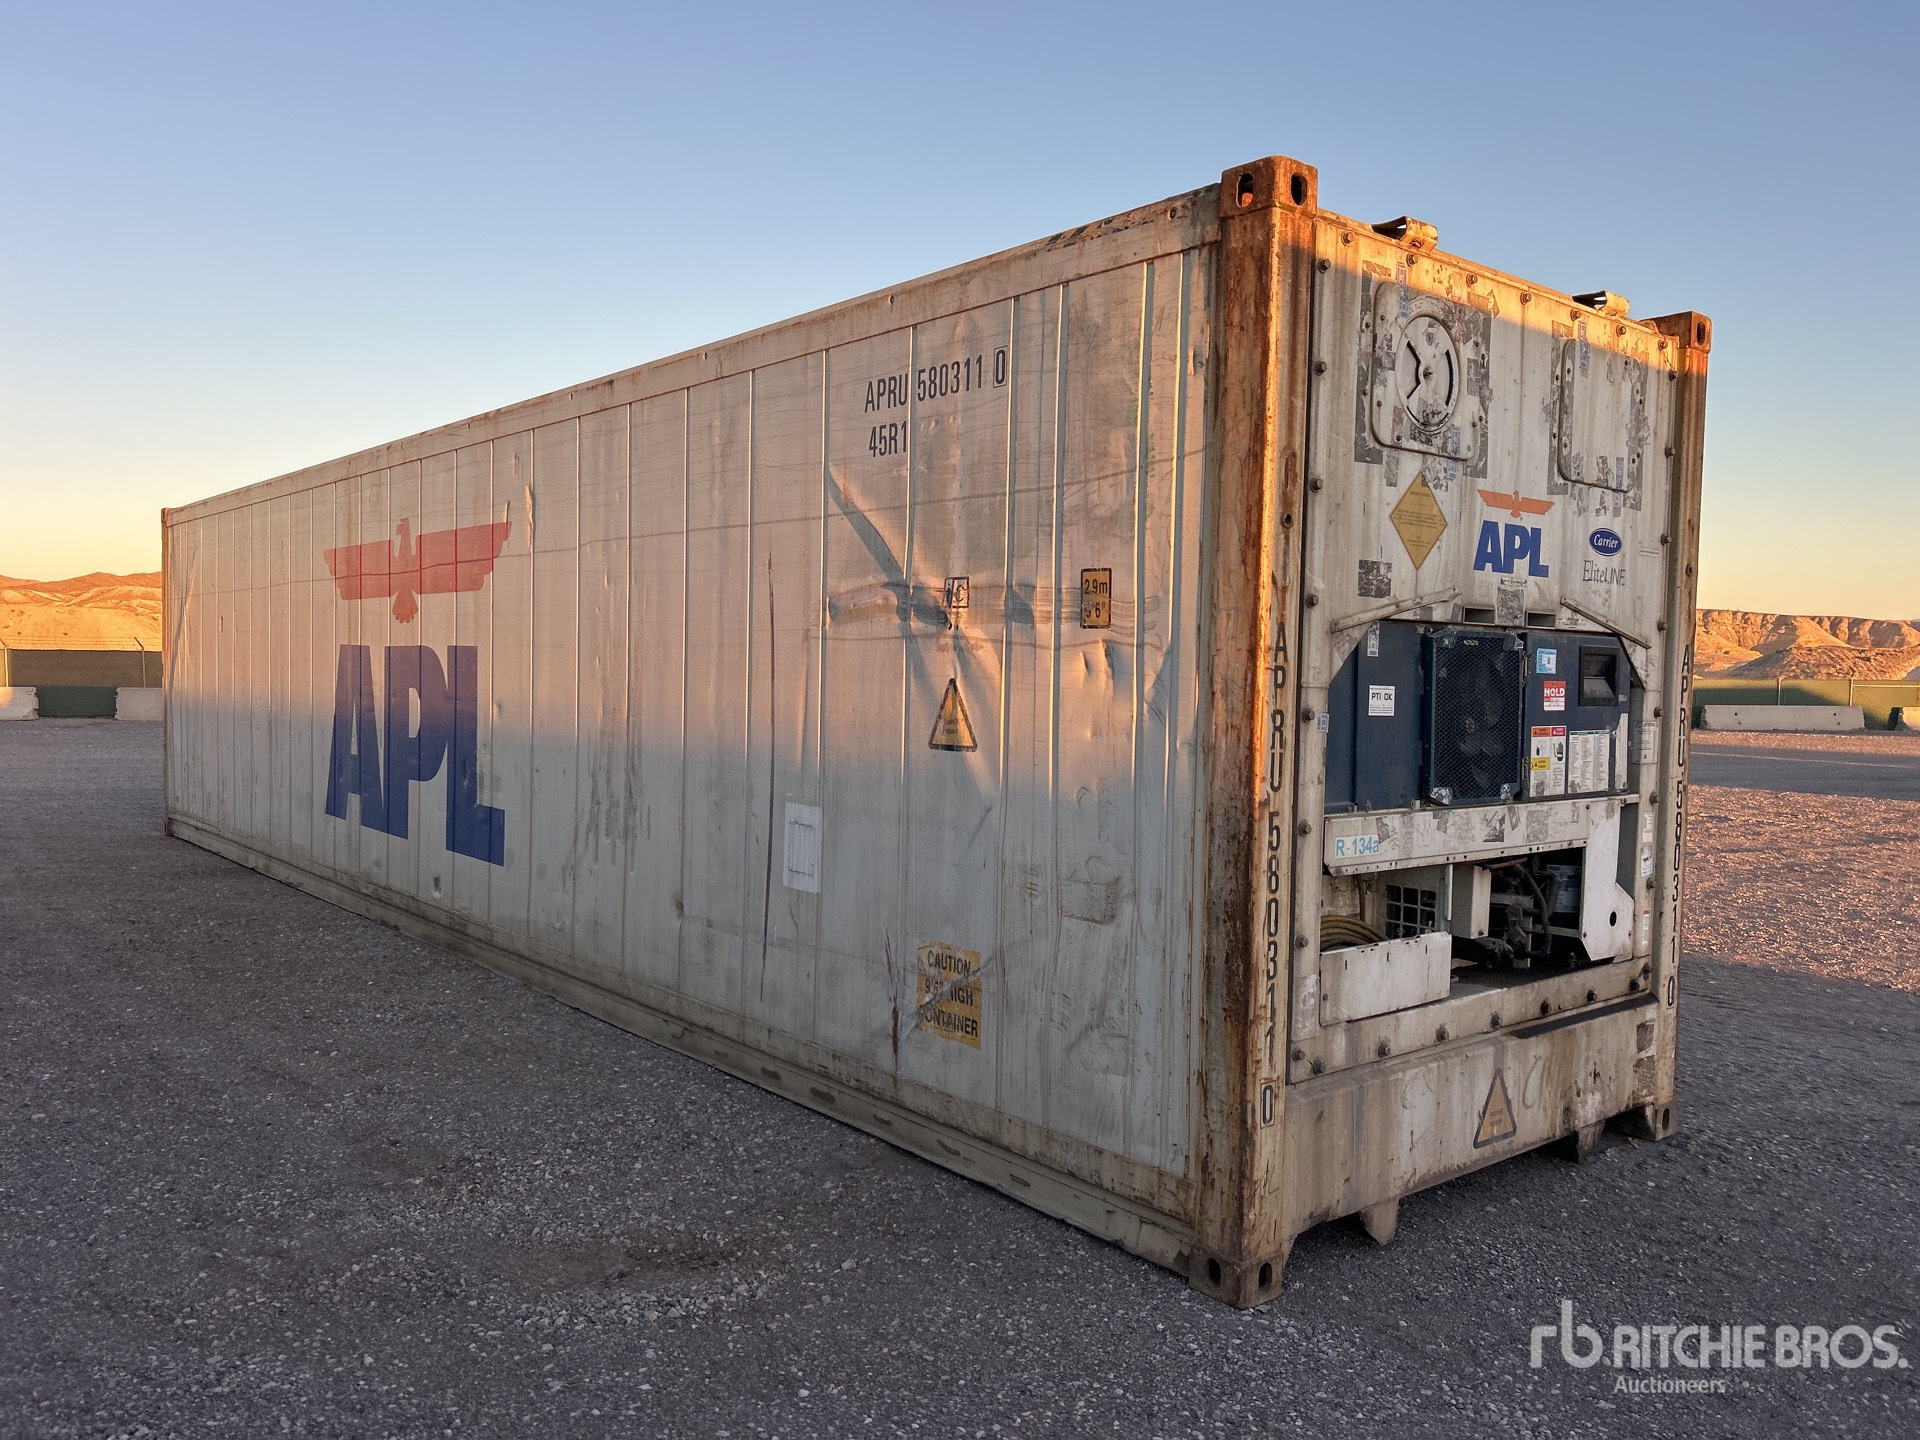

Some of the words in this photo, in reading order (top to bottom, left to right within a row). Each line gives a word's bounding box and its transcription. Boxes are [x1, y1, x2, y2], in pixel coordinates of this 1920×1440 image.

[864, 373, 908, 413] APRU
[917, 354, 983, 402] 580311
[995, 349, 1006, 385] 0
[868, 420, 907, 458] 45R1
[1473, 519, 1549, 578] APL
[1593, 533, 1619, 549] Carrier
[1371, 692, 1382, 701] PTI
[1383, 692, 1393, 701] OK
[1543, 687, 1566, 697] HOLD
[325, 643, 506, 868] APL
[927, 949, 971, 977] CAUTION
[922, 1007, 979, 1038] ONTAINER
